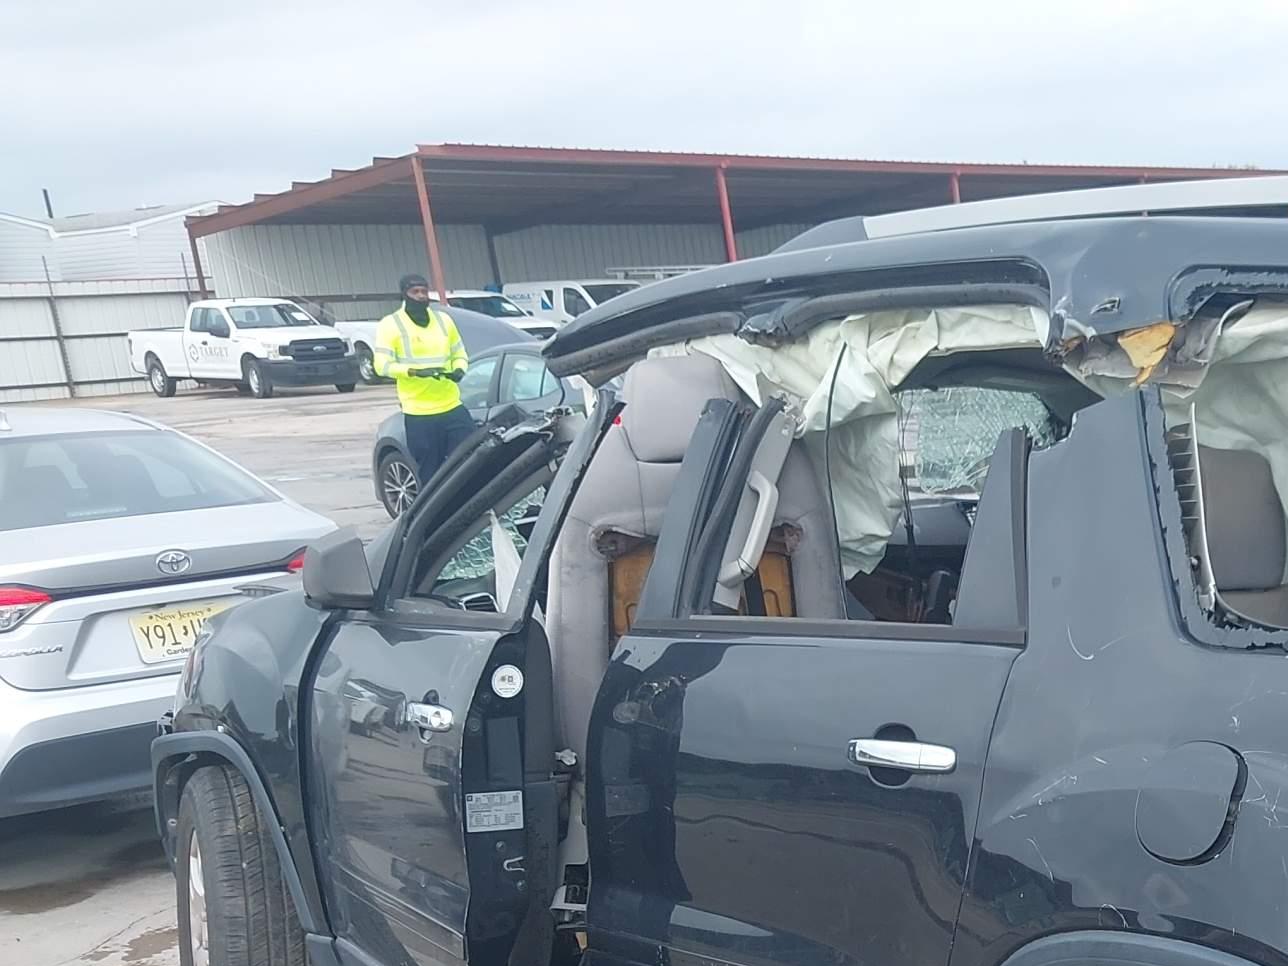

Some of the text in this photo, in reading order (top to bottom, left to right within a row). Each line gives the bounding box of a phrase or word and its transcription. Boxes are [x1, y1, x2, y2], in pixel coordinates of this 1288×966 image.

[155, 608, 204, 621] New Jersey
[140, 622, 182, 649] Y91
